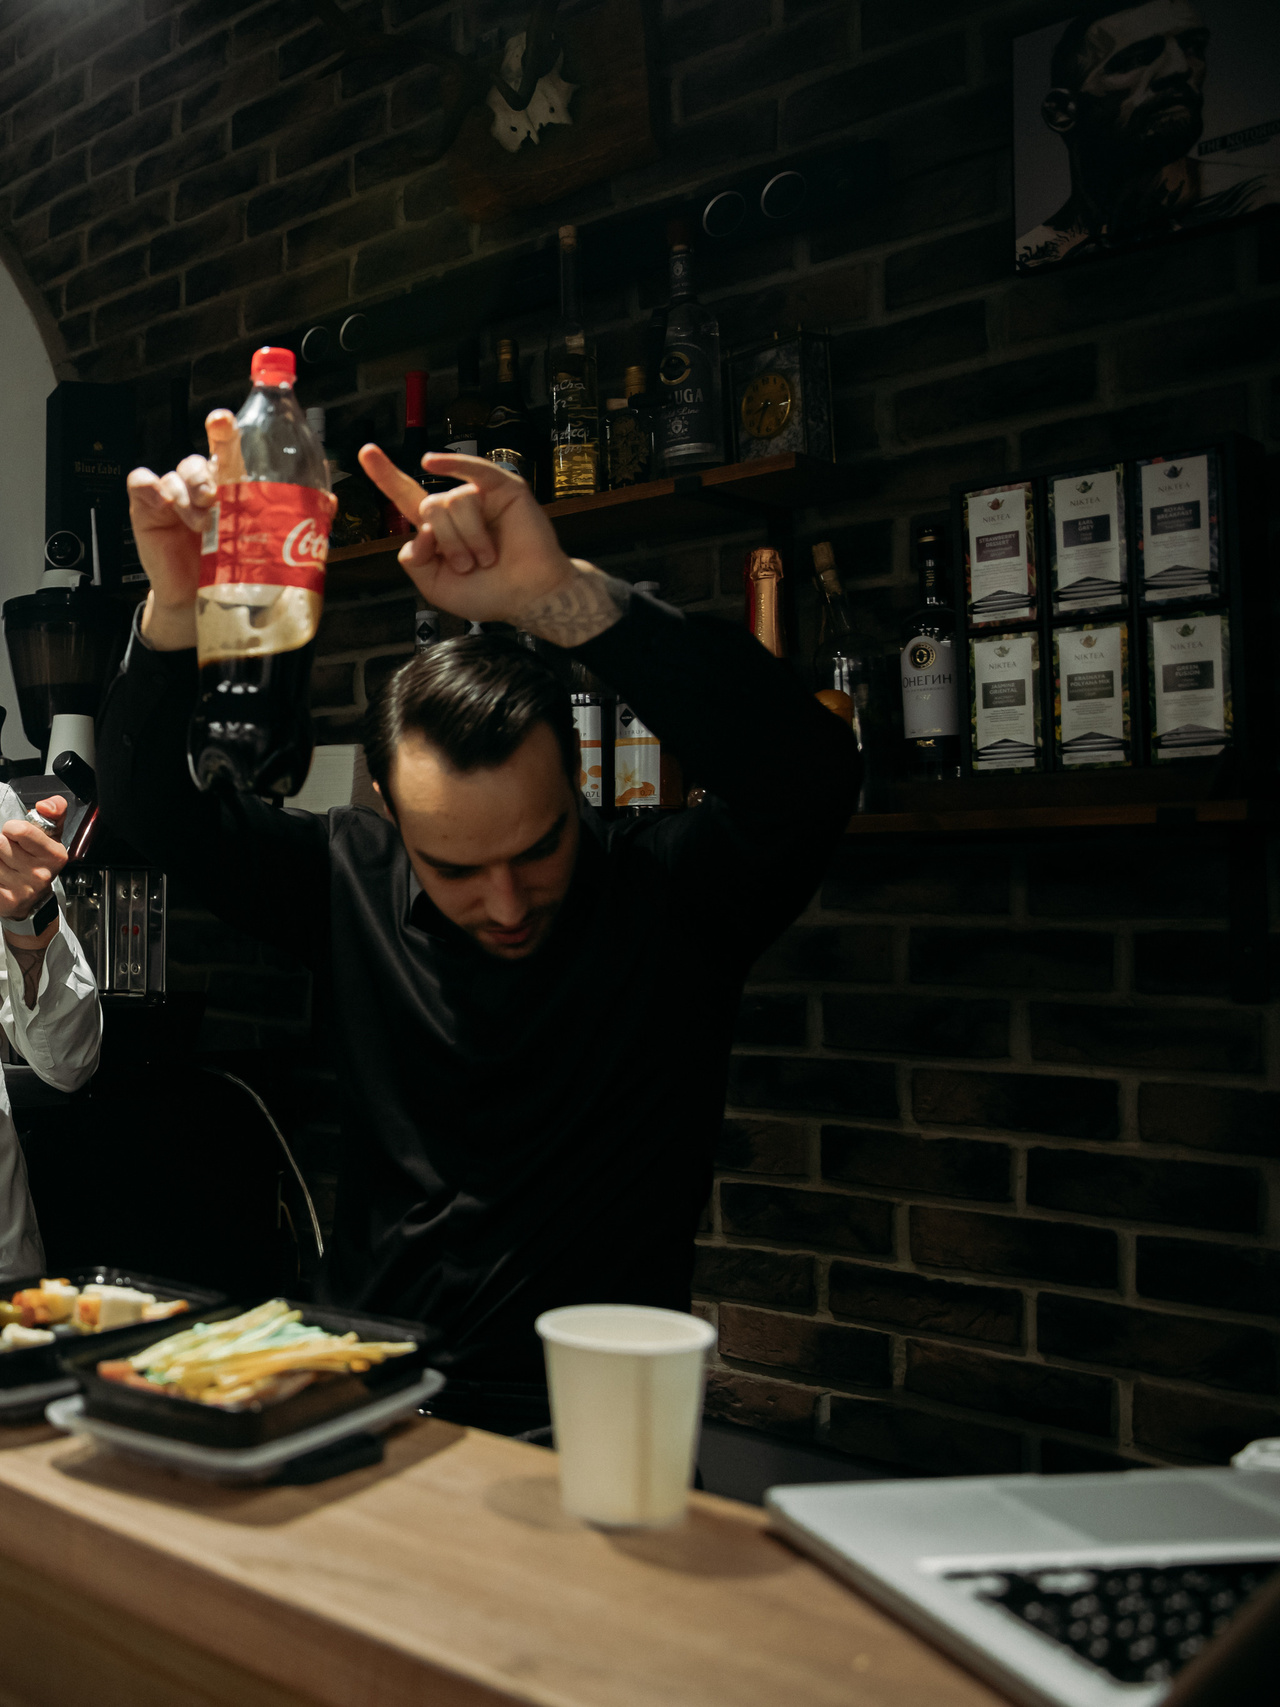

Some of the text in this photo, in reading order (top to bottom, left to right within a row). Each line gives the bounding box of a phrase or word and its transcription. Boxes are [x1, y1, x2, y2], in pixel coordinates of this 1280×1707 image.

[1201, 138, 1223, 155] THE
[670, 387, 704, 405] UGA
[97, 461, 121, 476] Label
[1070, 496, 1100, 507] NIKTEA
[982, 513, 1011, 524] NIKTEA
[1078, 524, 1095, 532] GREY
[979, 533, 1016, 544] STRAWBERRY
[985, 539, 1010, 548] DESSERT
[1171, 640, 1204, 651] NIKTEA
[1074, 652, 1105, 661] NIKTEA
[988, 661, 1017, 671] NIKTEA
[1176, 664, 1199, 672] GREEN
[1175, 669, 1201, 678] FUSION
[902, 673, 952, 689] ОНЕГИН
[989, 687, 1018, 696] ORIENTAL
